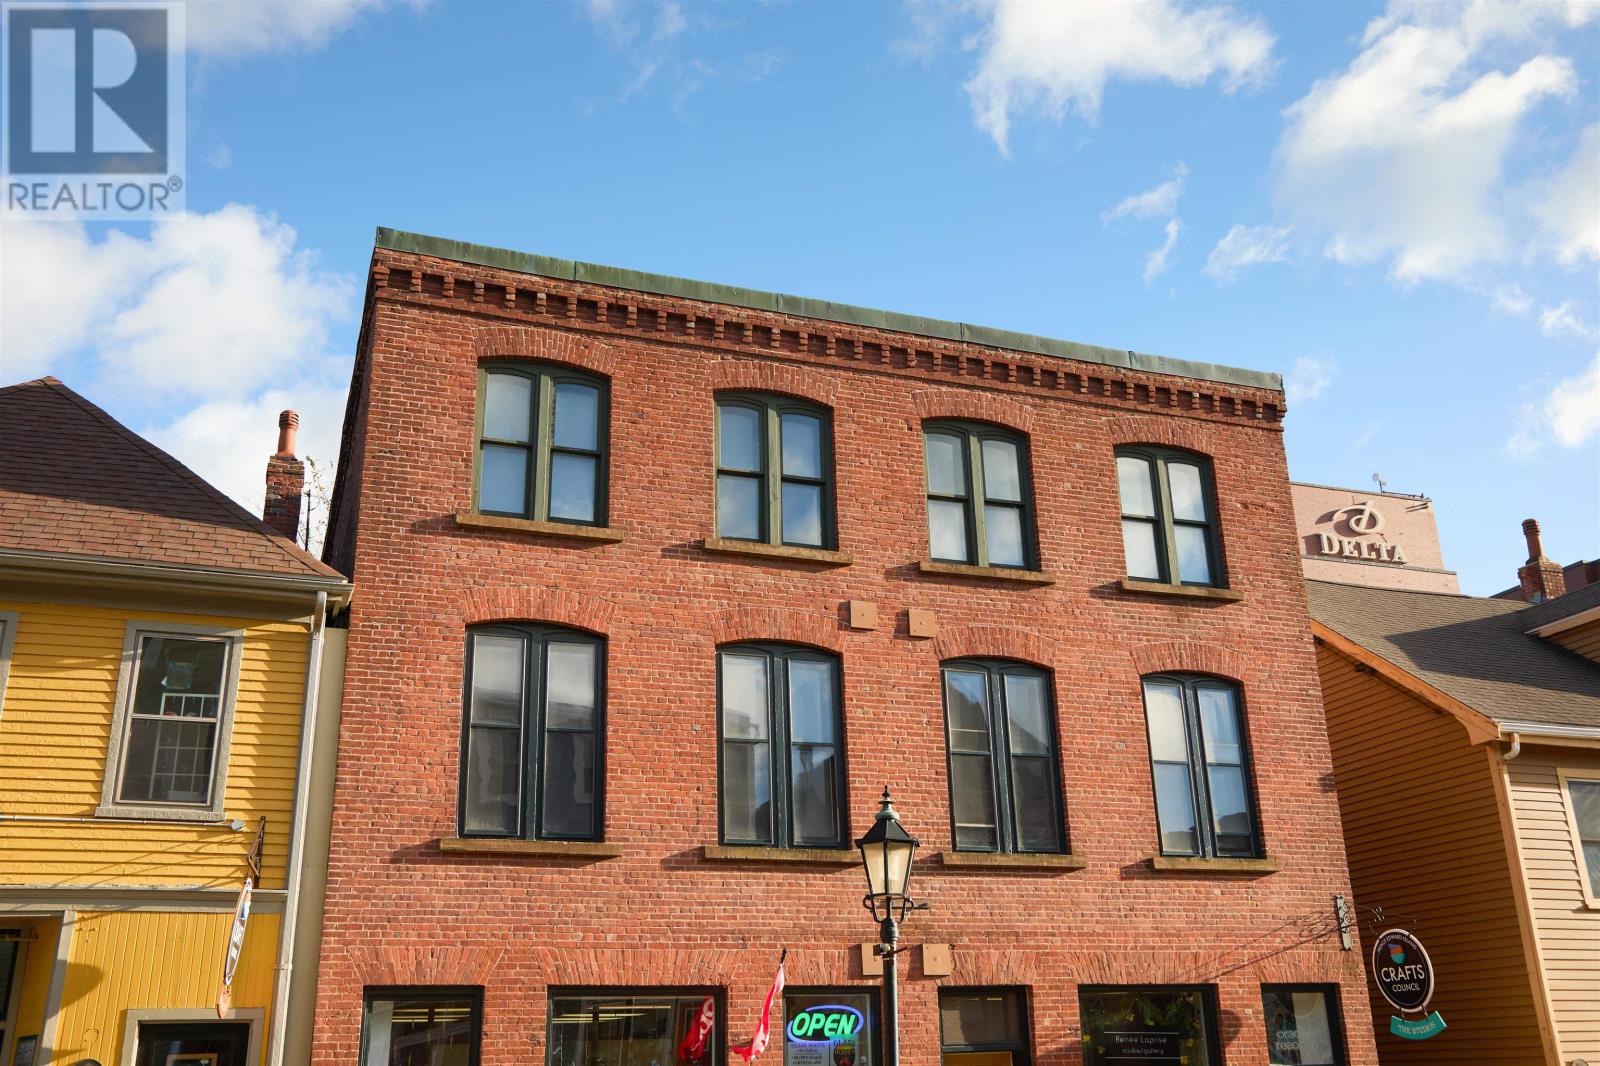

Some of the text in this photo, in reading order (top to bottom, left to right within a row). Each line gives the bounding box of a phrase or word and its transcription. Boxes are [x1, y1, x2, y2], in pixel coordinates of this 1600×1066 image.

[1319, 533, 1408, 563] DELTA
[1381, 964, 1425, 982] CRAFTS
[1392, 983, 1420, 992] COUNCIL
[792, 1012, 857, 1036] OPEN
